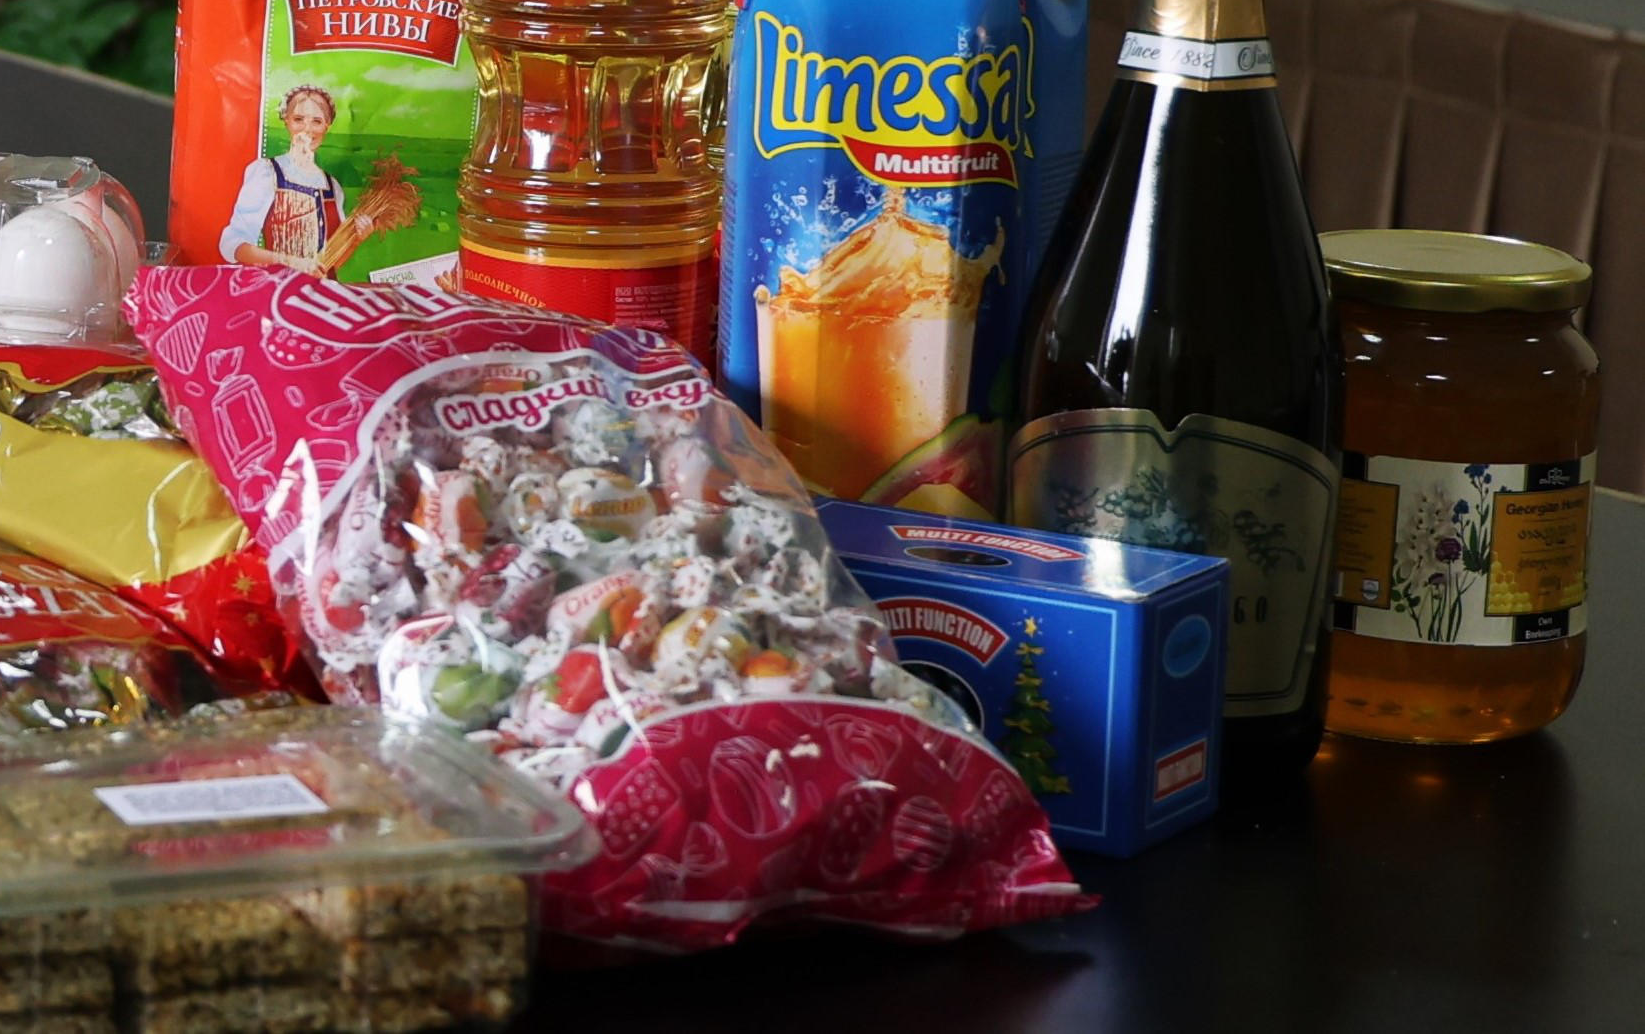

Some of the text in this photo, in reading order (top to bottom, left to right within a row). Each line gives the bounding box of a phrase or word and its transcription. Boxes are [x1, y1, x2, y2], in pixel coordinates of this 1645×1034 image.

[322, 11, 431, 43] НИВЫ
[874, 152, 999, 175] Multifruit
[441, 373, 616, 432] сладкий
[905, 529, 970, 542] MULTI
[914, 609, 996, 654] FUNCTION
